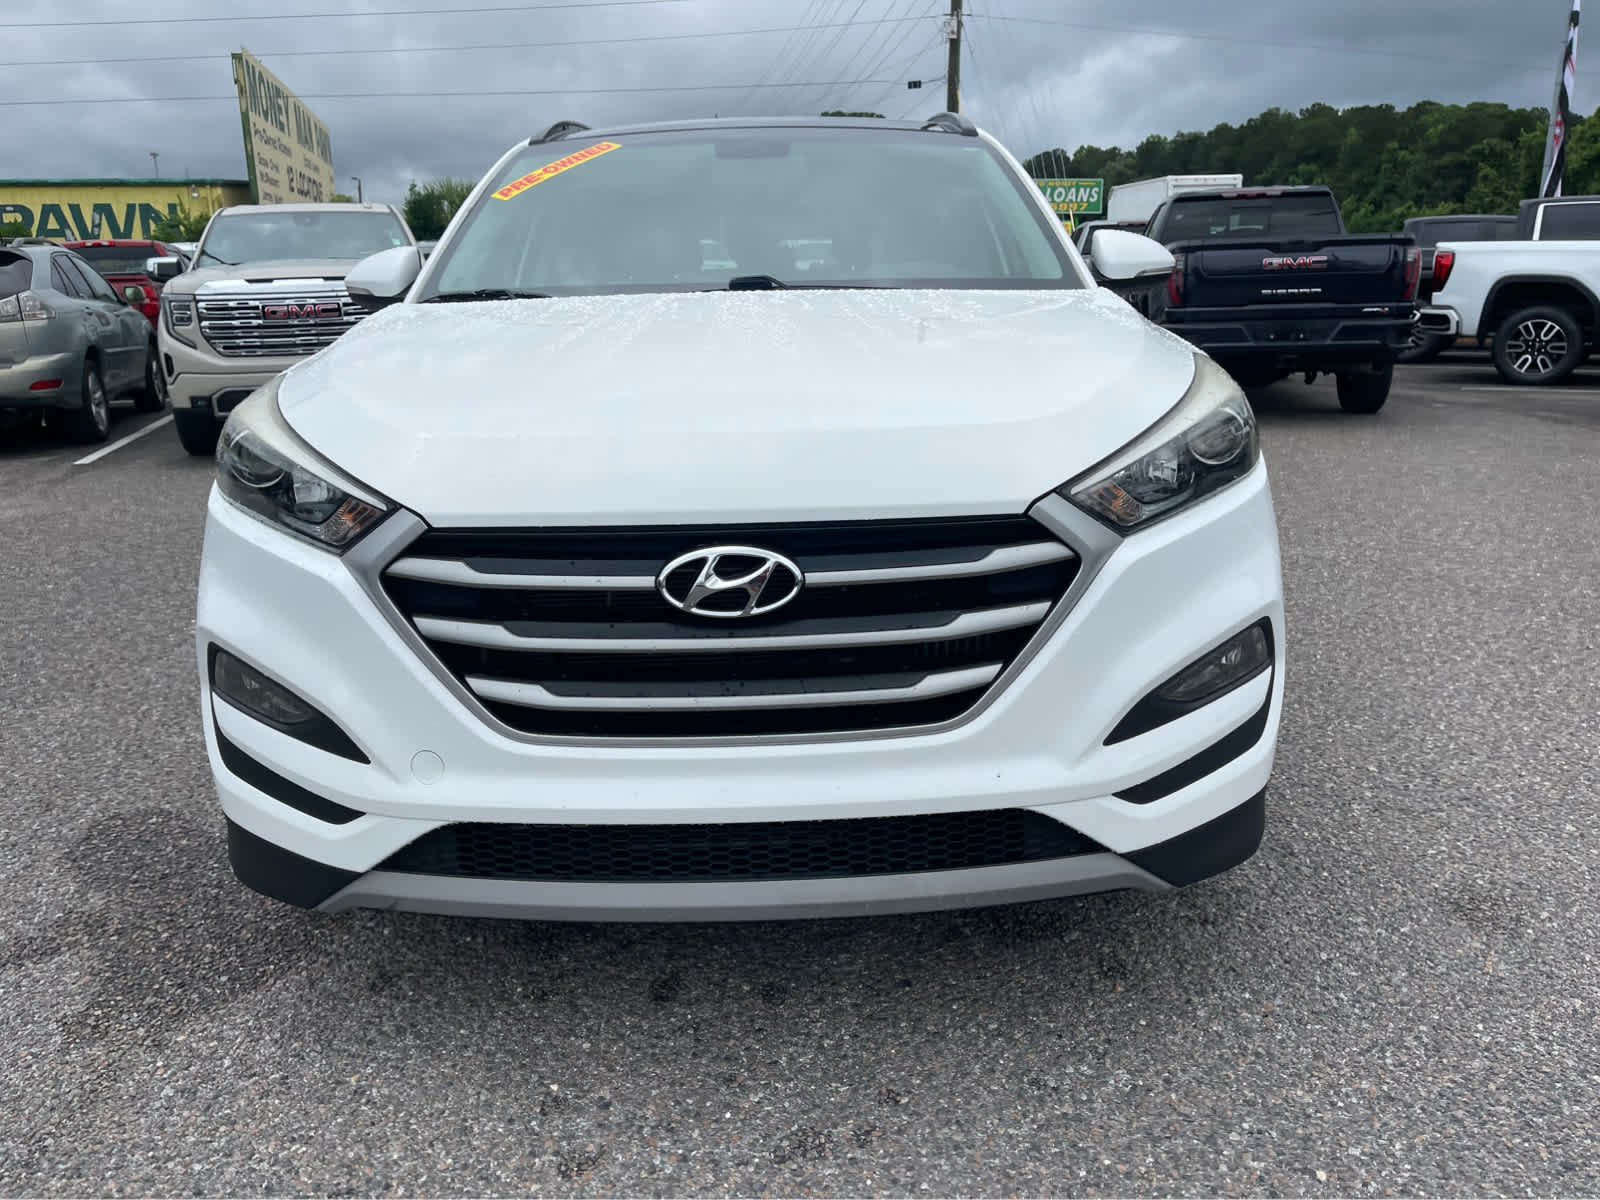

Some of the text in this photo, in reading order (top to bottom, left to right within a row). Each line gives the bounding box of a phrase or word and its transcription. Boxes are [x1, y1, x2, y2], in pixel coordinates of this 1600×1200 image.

[245, 58, 291, 136] MONEY
[500, 143, 613, 198] PRE-OWNED
[1046, 187, 1100, 203] LOANS
[1262, 255, 1328, 270] GMC
[264, 303, 339, 320] GMC
